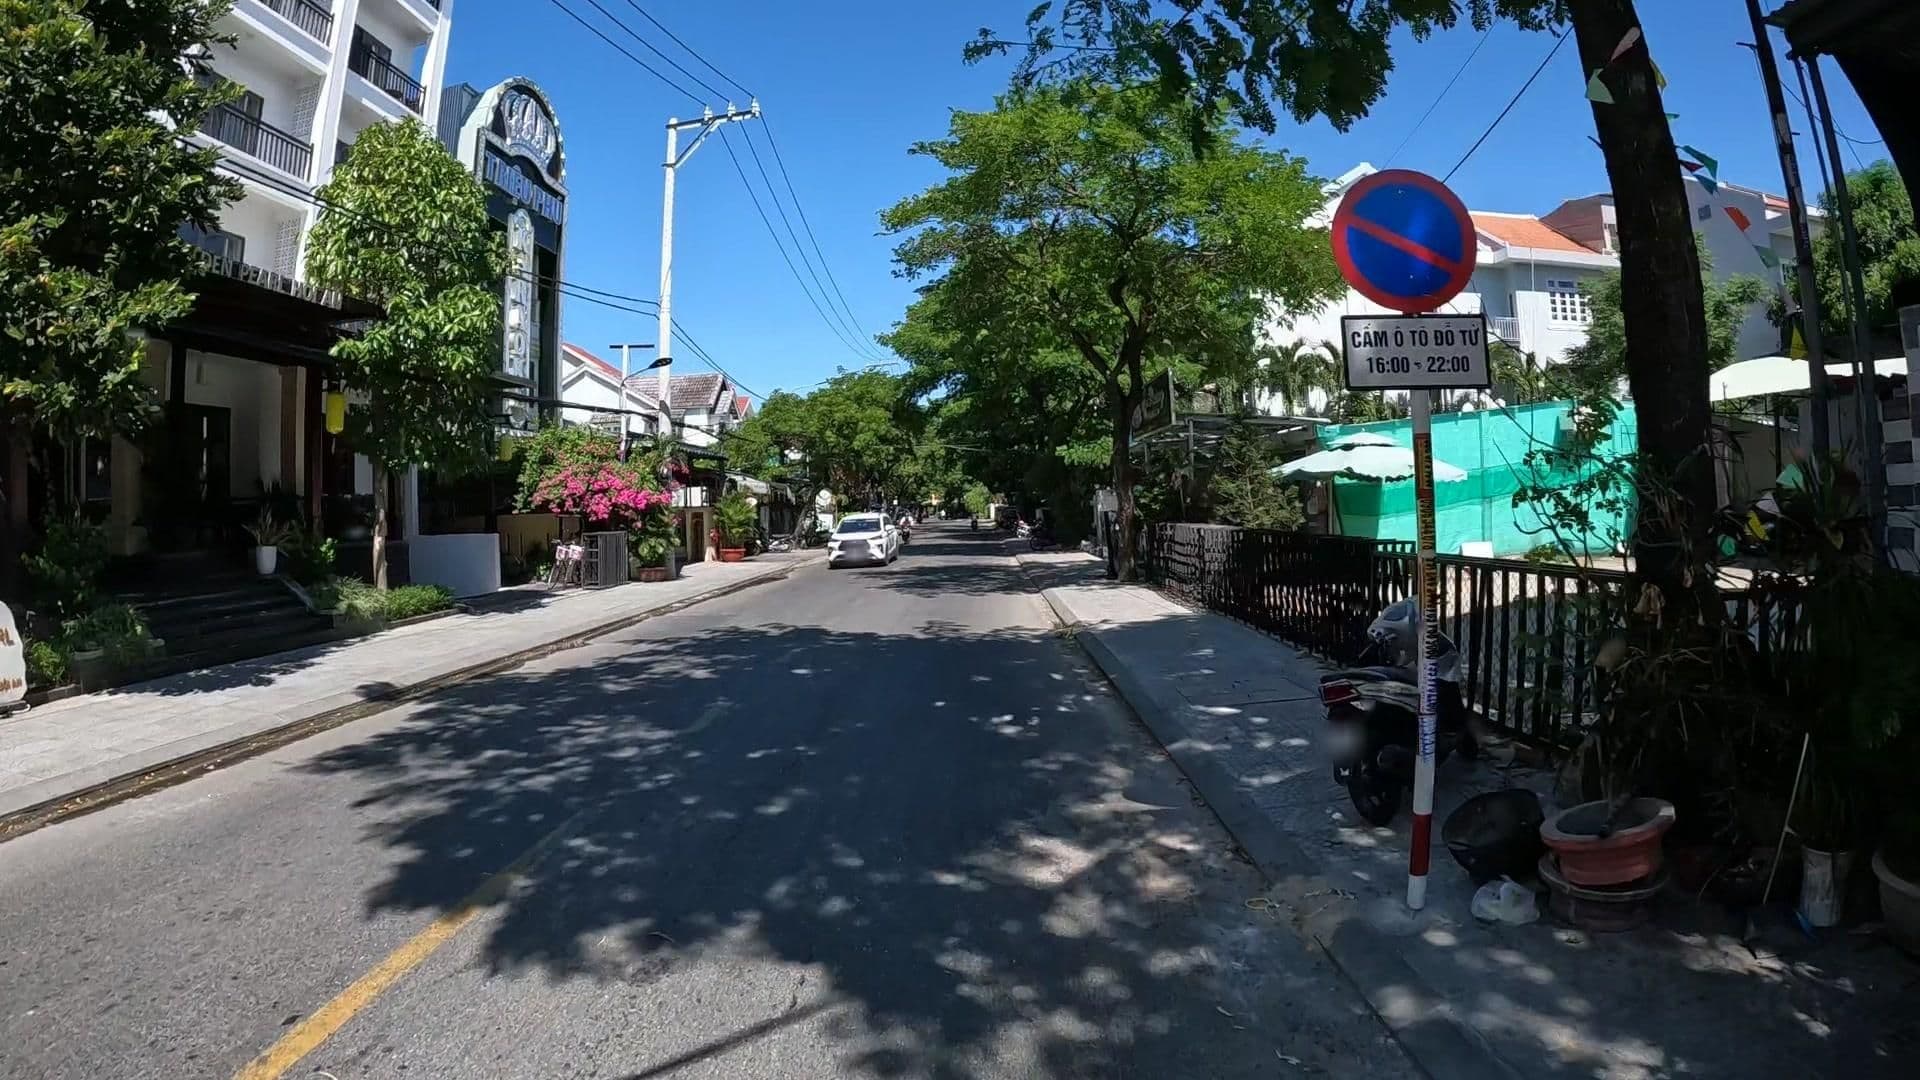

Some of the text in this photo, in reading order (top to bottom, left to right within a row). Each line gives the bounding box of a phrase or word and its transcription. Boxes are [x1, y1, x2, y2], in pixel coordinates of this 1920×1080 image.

[532, 184, 564, 226] PHÚ
[1351, 322, 1480, 349] CẤM Ô TÔ ĐỖ TỪ
[1366, 356, 1411, 374] 16:00
[1426, 356, 1471, 374] 22:00
